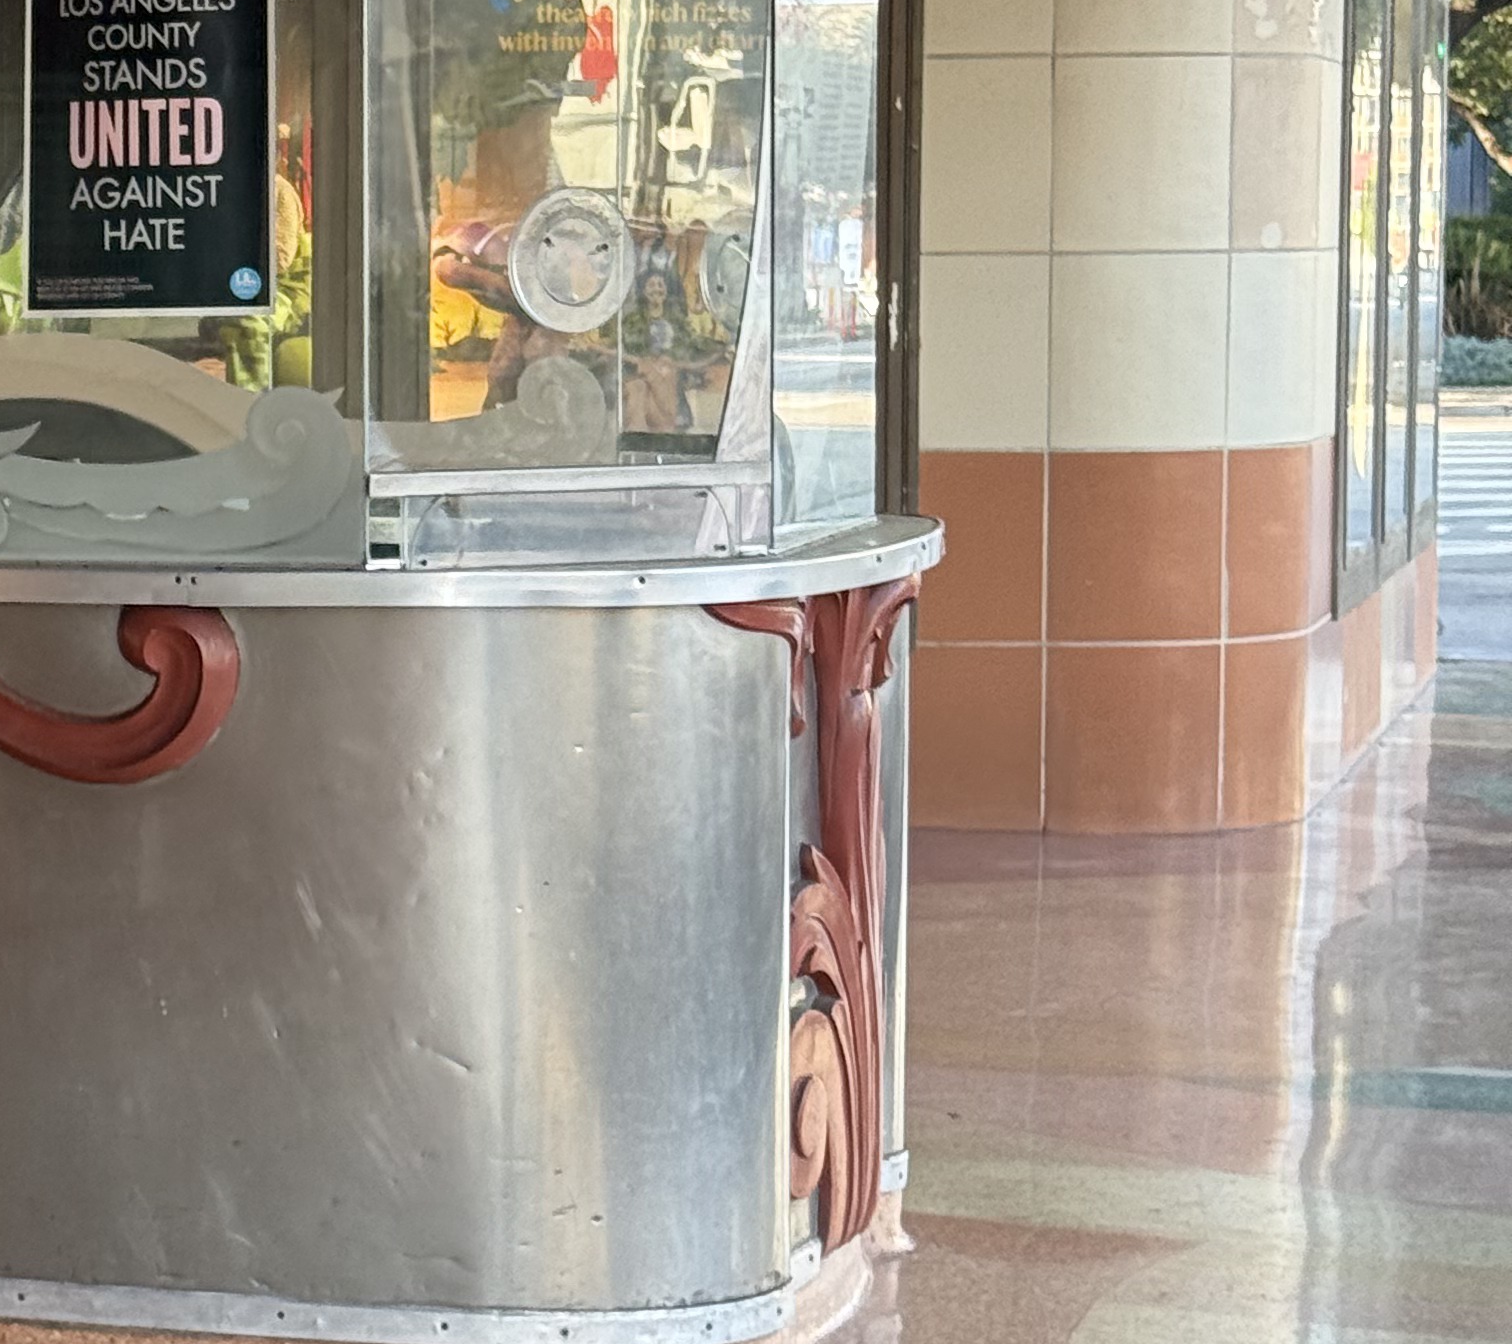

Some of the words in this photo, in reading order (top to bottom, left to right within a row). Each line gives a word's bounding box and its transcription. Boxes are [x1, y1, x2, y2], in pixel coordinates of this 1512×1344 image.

[87, 20, 202, 52] COUNTY
[497, 29, 548, 53] with
[659, 30, 703, 52] and
[82, 57, 208, 92] STANDS
[69, 97, 224, 170] UNITED
[69, 174, 224, 212] AGAINST
[102, 217, 186, 252] HATE
